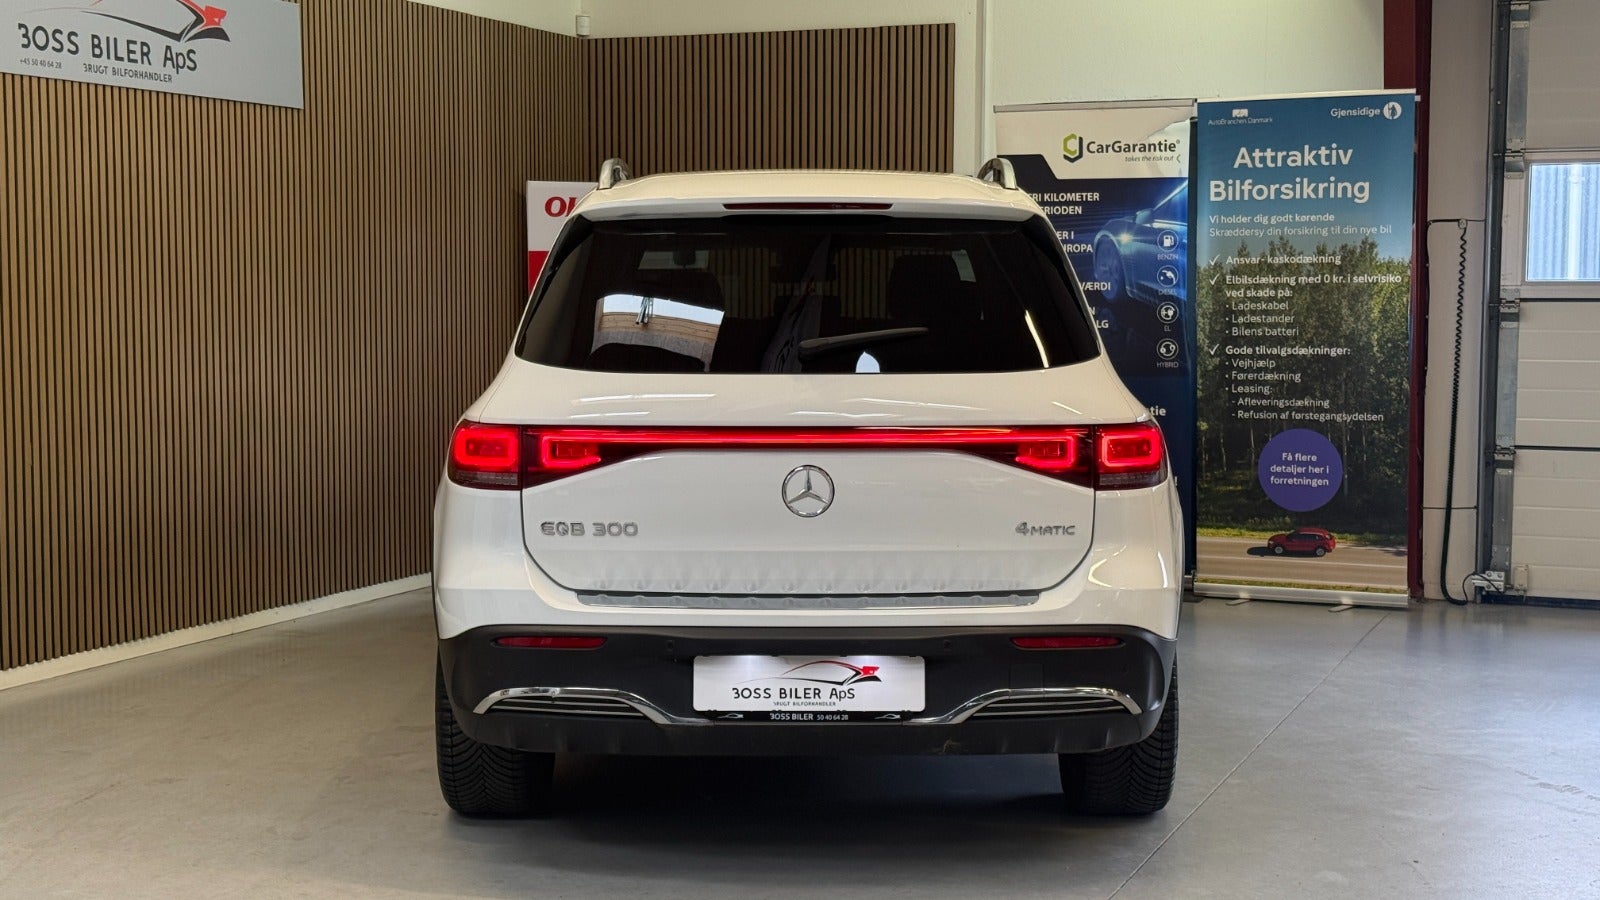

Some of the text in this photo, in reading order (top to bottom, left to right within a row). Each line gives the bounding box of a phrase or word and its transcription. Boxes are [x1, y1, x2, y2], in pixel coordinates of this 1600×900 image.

[91, 34, 152, 66] BILER
[163, 45, 198, 75] ApS
[112, 67, 173, 83] BILFORHANDLER
[1330, 108, 1380, 118] Gjensidige
[1234, 144, 1353, 168] Attraktiv
[1210, 176, 1370, 204] Bilforsikring
[1044, 192, 1100, 202] KILOMETER
[1210, 213, 1334, 225] Vi holder dig godt kørende
[1210, 226, 1392, 238] Skræddersy din forsikring til din nye bil
[1267, 255, 1342, 266] kaskodækning
[1226, 276, 1296, 286] Elbilsdækning
[1298, 276, 1322, 284] med
[1332, 275, 1346, 283] kr.
[1353, 274, 1402, 283] selvrisiko
[1226, 288, 1292, 298] ved skade på:
[1232, 302, 1288, 310] Ladeskabel
[1232, 315, 1294, 323] Ladestander
[1232, 327, 1299, 336] Bilens batteri
[1226, 346, 1350, 356] Gode tilvalgsdækninger:
[1232, 359, 1276, 370] Vejhjælp
[1232, 372, 1302, 382] Førerdækning
[1232, 384, 1272, 394] Leasing:
[1238, 398, 1330, 408] Afleveringsdækning
[1238, 410, 1384, 422] Refusion af førstegangsydelsen
[1282, 452, 1318, 462] Få flere
[1270, 464, 1306, 474] detaljer
[1308, 465, 1324, 474] her
[1270, 476, 1329, 487] forretningen
[540, 521, 638, 536] EQB 300
[1015, 522, 1076, 536] 4MATIC
[779, 688, 821, 699] BILER
[830, 688, 855, 702] ApS
[792, 712, 814, 720] BILER
